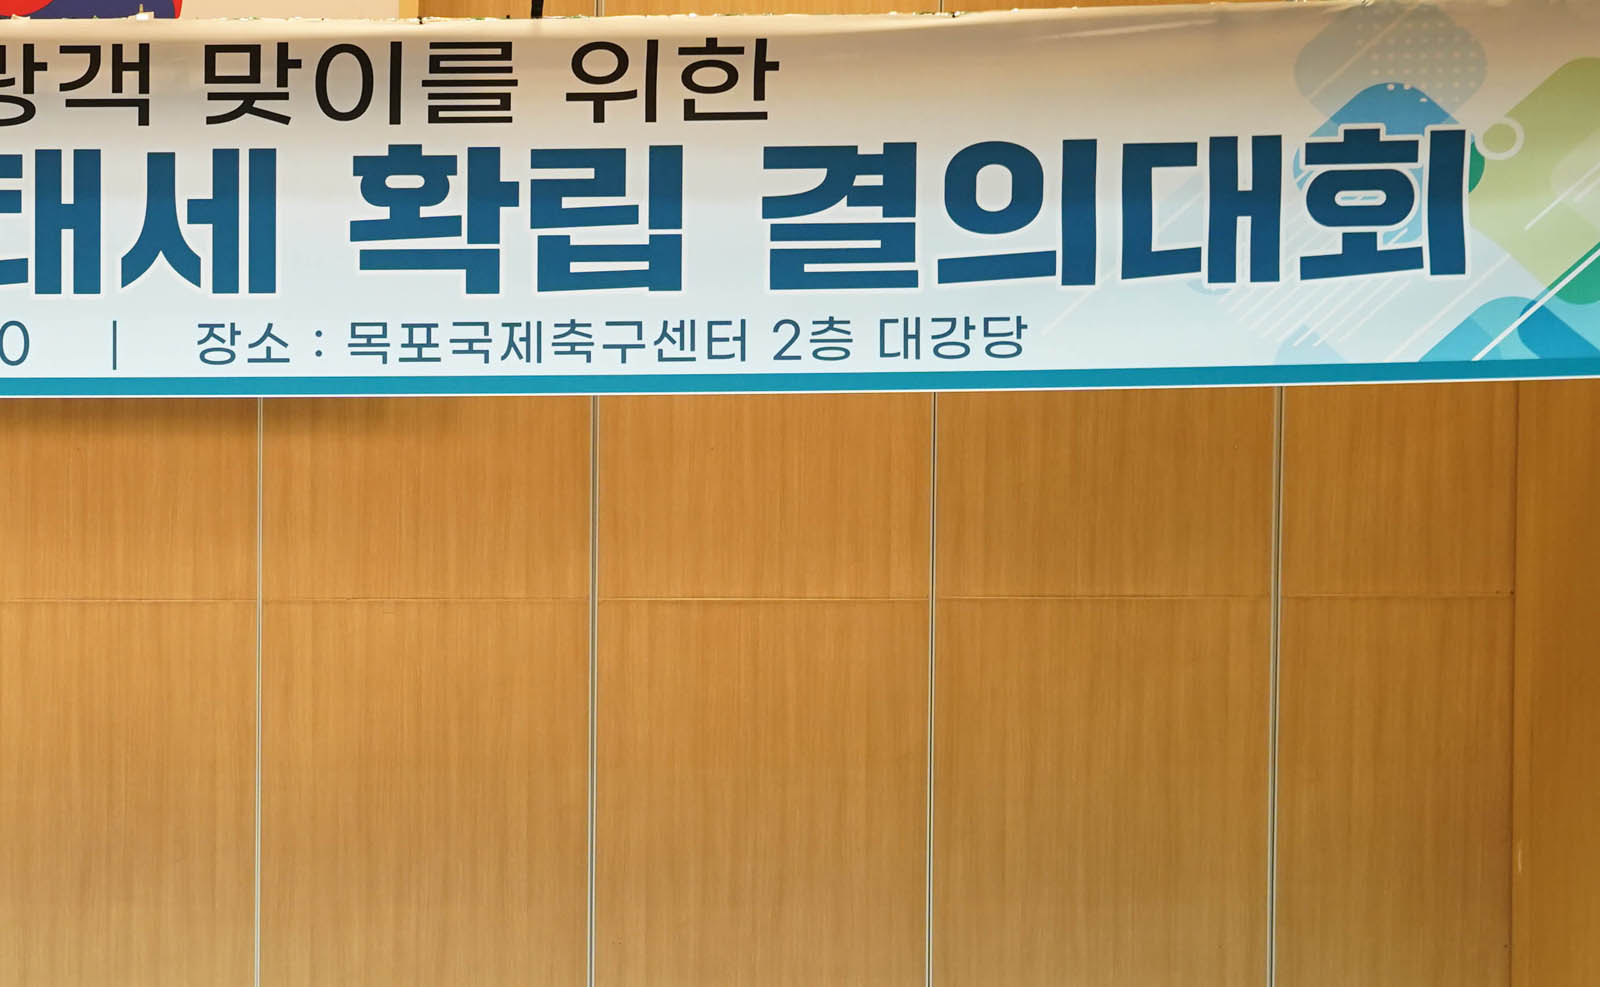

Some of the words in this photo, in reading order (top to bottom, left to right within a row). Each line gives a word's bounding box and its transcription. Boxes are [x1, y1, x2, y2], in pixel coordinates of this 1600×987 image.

[204, 40, 519, 126] 맞이를
[565, 36, 780, 124] 위한
[349, 143, 684, 295] 확립
[761, 127, 1467, 291] 결의대회
[347, 318, 747, 365] 목포국제축구센터
[772, 315, 854, 362] 2층
[879, 315, 1028, 361] 대강당
